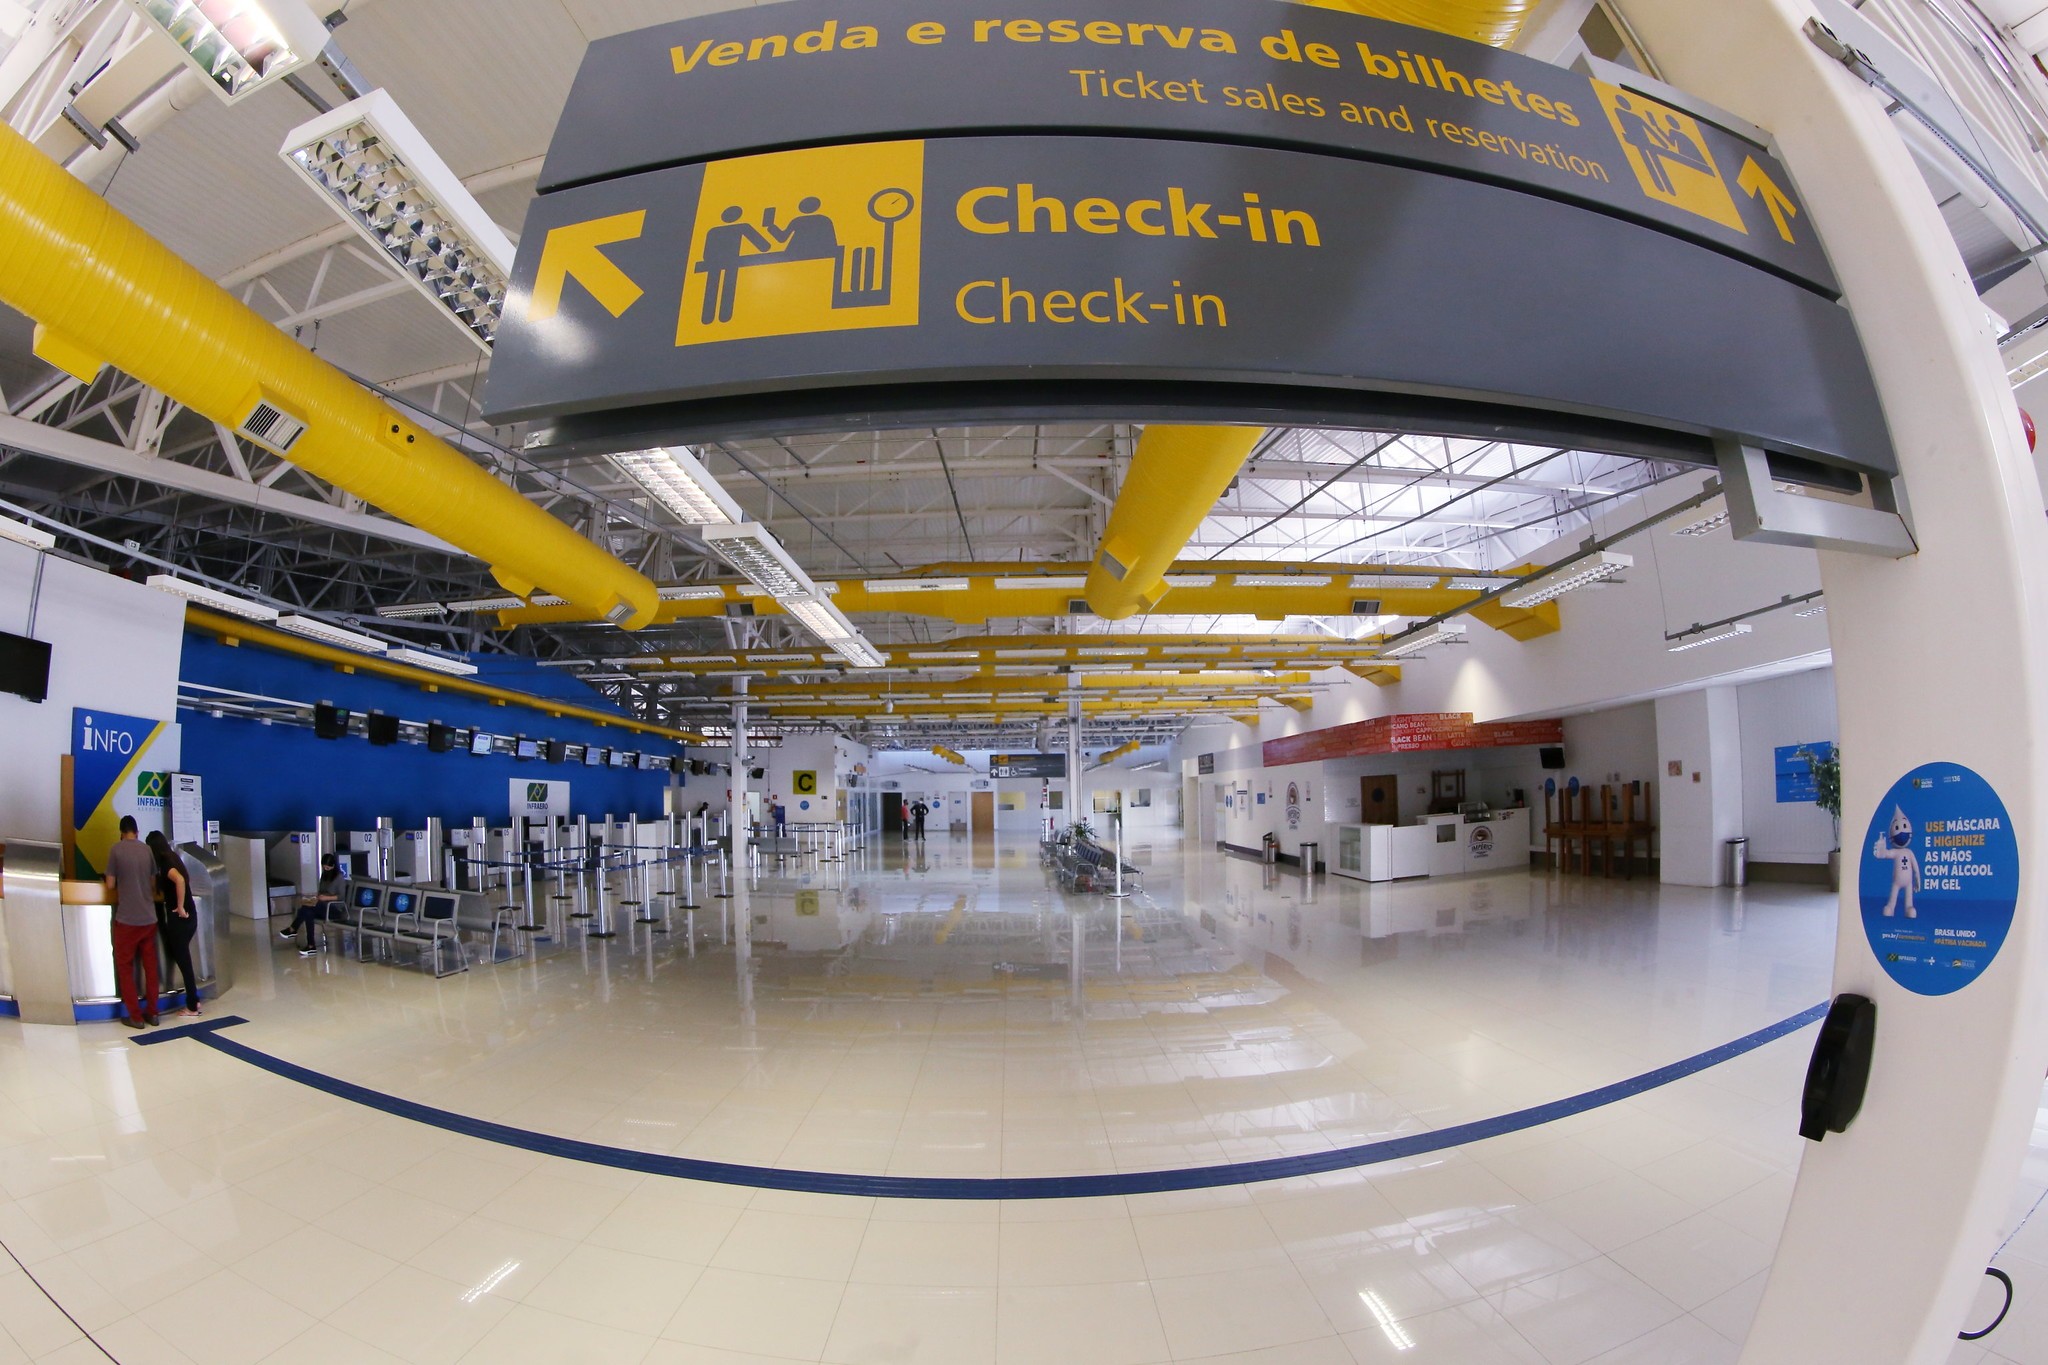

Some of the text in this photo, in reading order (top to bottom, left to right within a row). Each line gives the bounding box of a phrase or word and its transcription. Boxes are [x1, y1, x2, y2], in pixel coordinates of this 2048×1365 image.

[669, 19, 1580, 127] Venda e reserva de bilhetes
[1070, 69, 1610, 183] Ticket sales and reservation
[955, 183, 1322, 247] Check-in
[954, 276, 1228, 328] Check-in
[1413, 734, 1433, 742] BEAN
[798, 774, 813, 792] C
[526, 802, 549, 810] INFRAERO
[1925, 816, 2001, 833] USE MÁSCARA
[301, 834, 310, 843] 01
[364, 833, 372, 842] 02
[416, 831, 423, 840] 03
[1925, 833, 1986, 848] E HIGIENIZE
[1925, 848, 1972, 862] AS MÃOS
[1925, 862, 1993, 876] COM ÁLCOOL
[1924, 879, 1961, 890] EM GEL
[1934, 928, 1977, 938] BRASIL UNIDO
